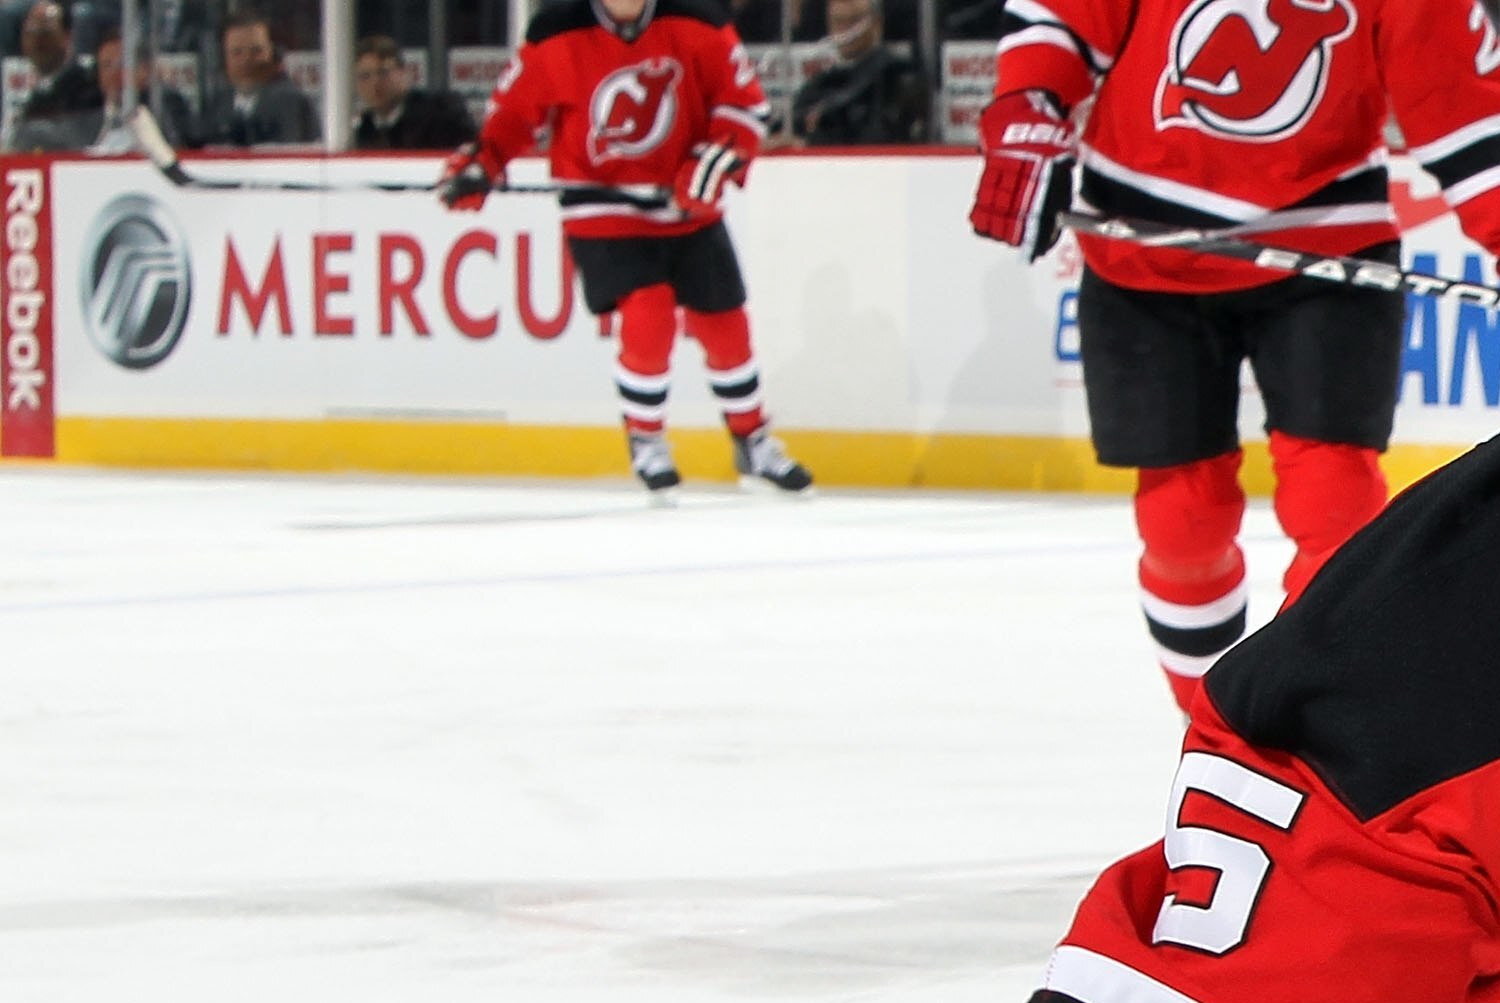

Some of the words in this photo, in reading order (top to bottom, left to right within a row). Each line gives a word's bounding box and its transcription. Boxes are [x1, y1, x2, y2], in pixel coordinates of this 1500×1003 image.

[6, 168, 46, 410] Reebok
[216, 229, 614, 341] MERCU
[1150, 750, 1308, 957] 5
